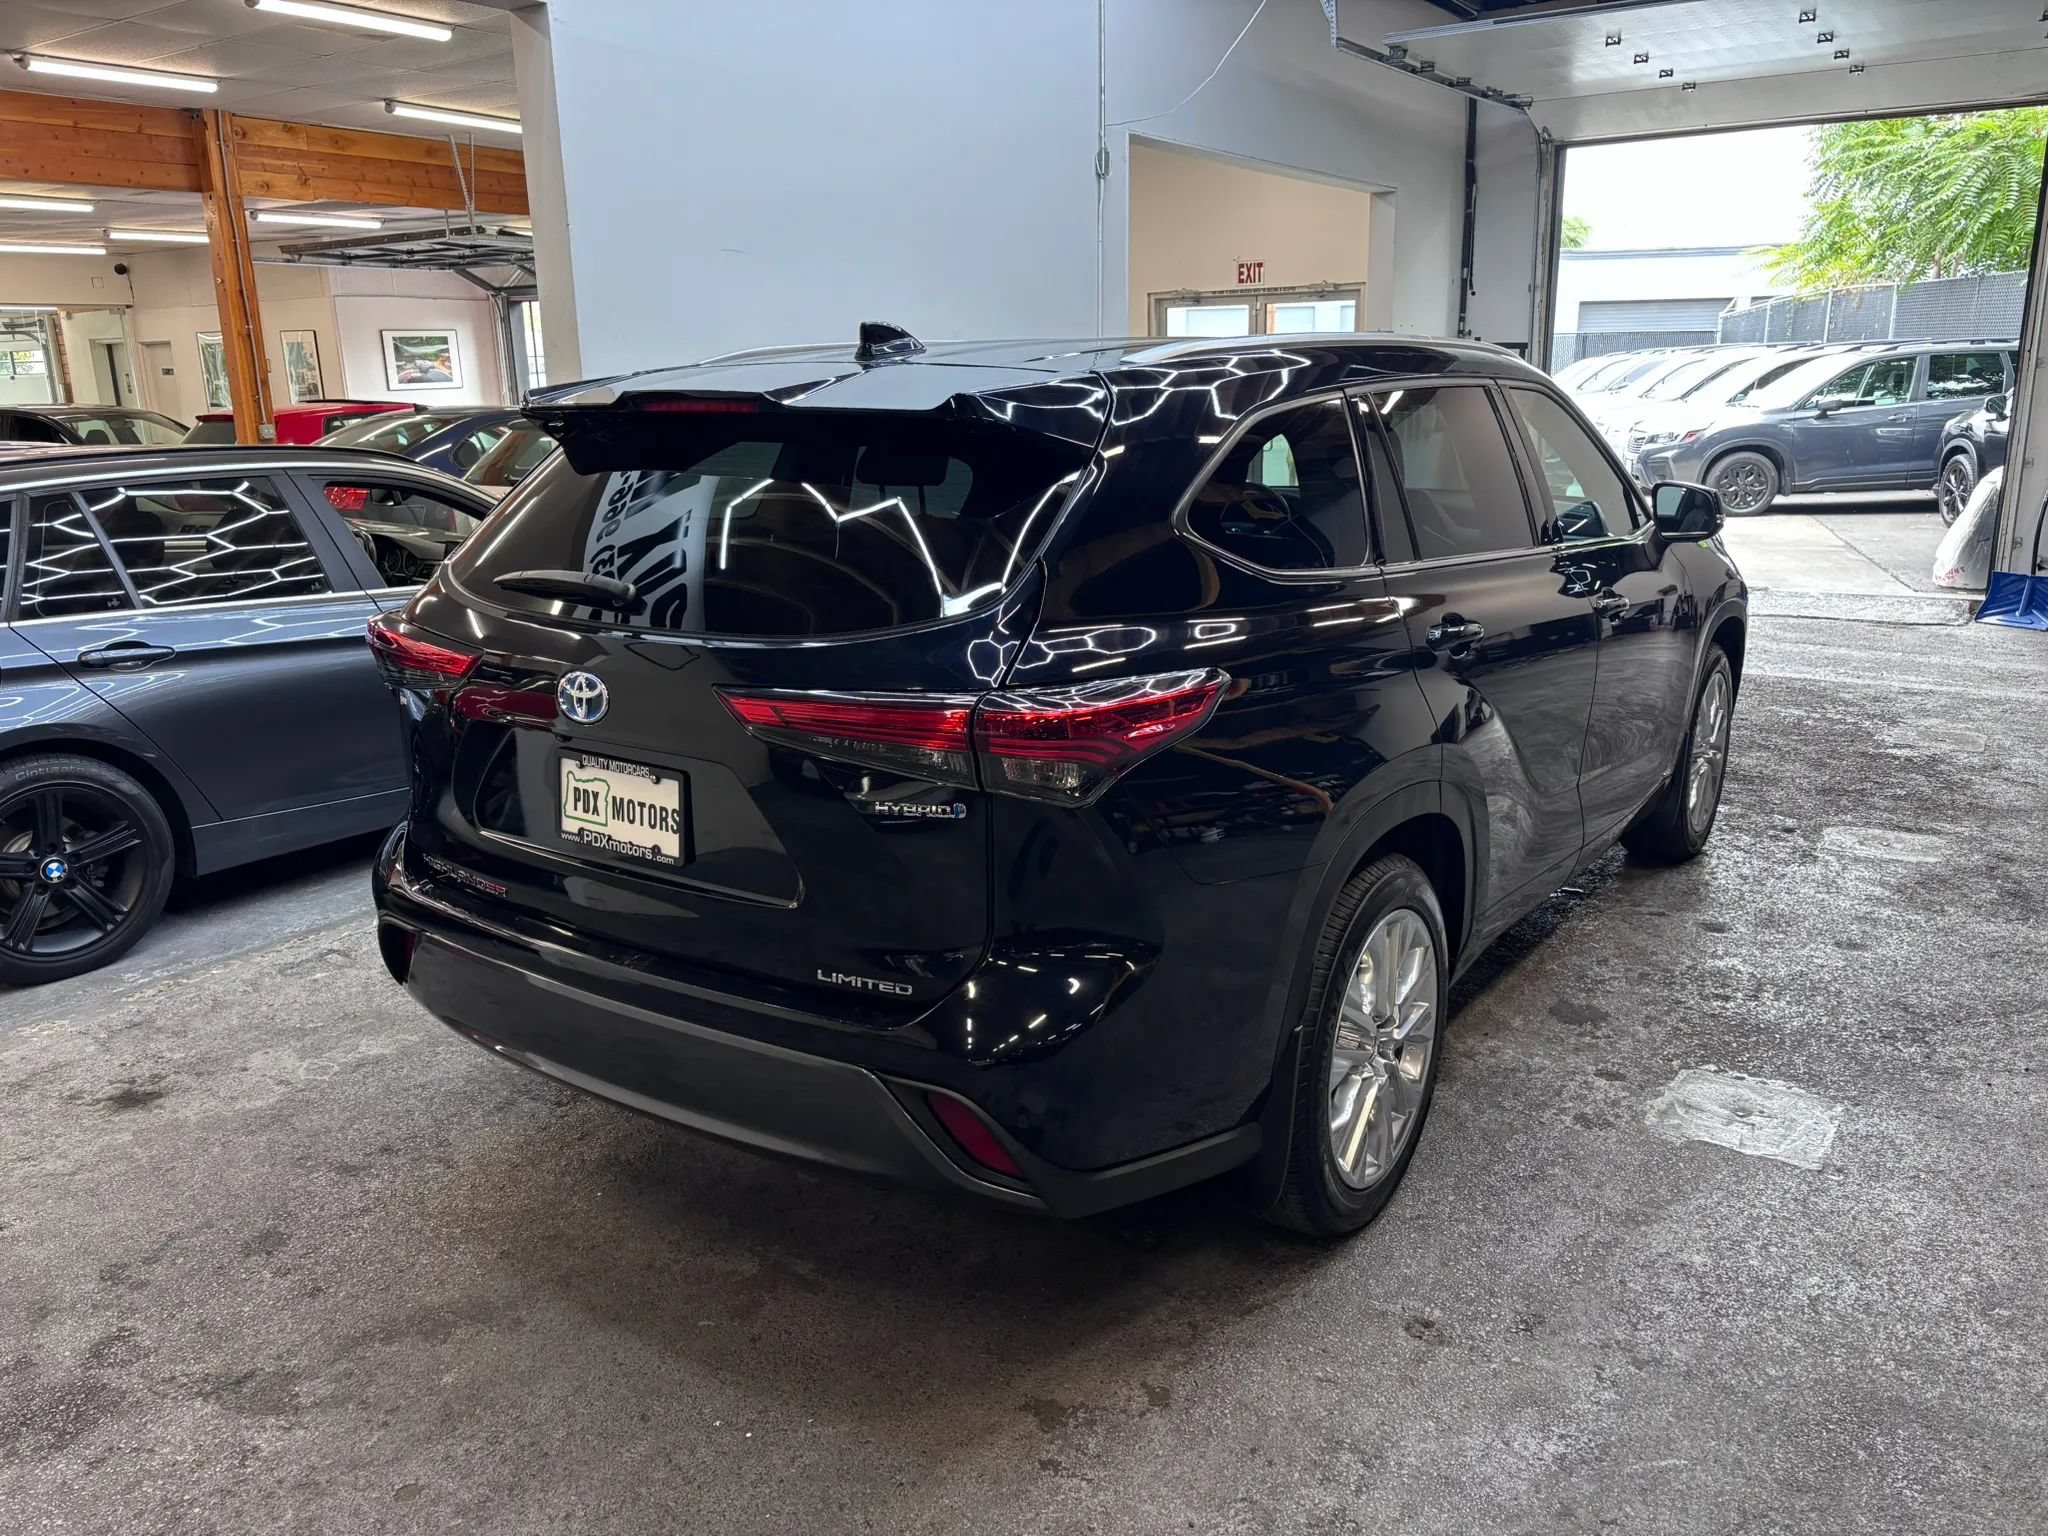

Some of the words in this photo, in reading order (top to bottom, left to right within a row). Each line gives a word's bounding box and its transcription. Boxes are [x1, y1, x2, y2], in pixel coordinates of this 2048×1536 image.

[1238, 262, 1264, 284] EXIT
[582, 755, 608, 771] QUALITY
[608, 760, 651, 778] MOTORCARS
[573, 786, 600, 817] PDX
[611, 795, 680, 835] MOTORS
[875, 801, 951, 818] HYBRID
[561, 830, 675, 865] www.PDXmotors.com
[817, 969, 913, 996] LIMITED
